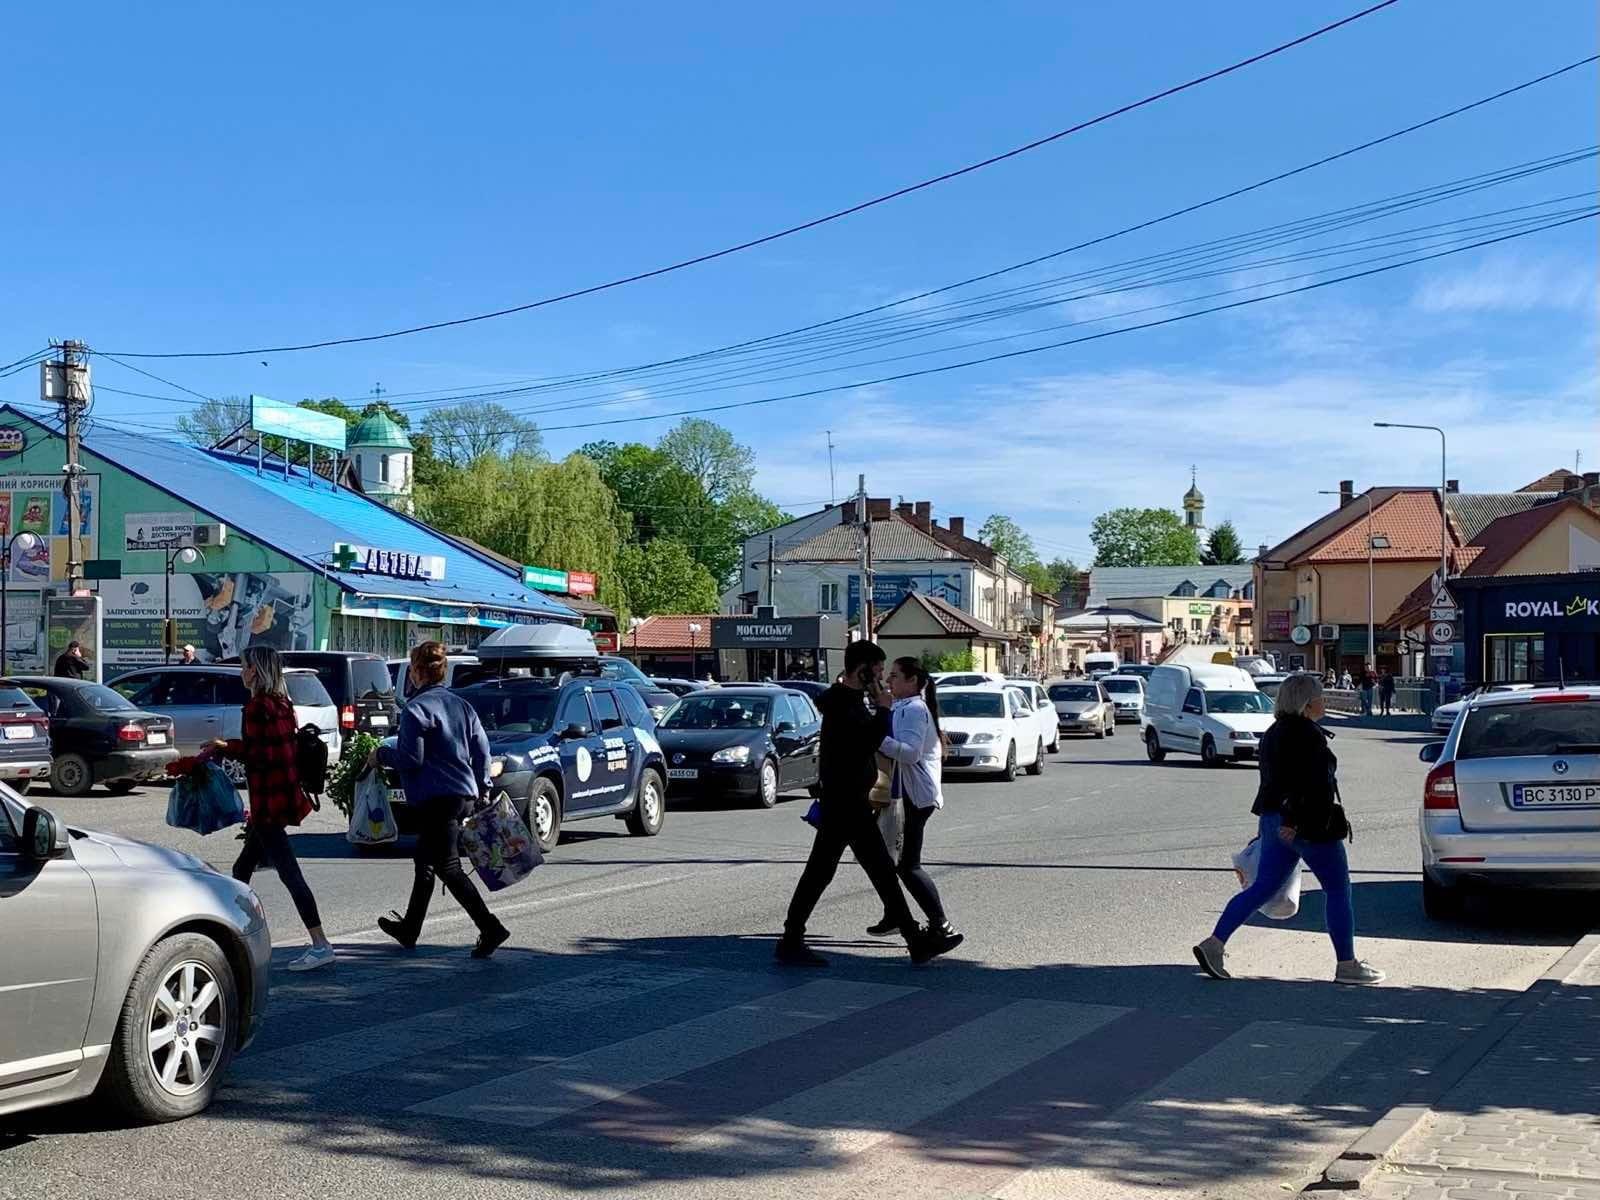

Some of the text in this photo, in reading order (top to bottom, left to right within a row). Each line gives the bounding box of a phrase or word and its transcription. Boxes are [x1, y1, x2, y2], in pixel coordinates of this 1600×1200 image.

[21, 479, 64, 489] КОРИСНИ
[367, 549, 425, 577] АПТЕКА
[1505, 601, 1564, 617] ROYAL
[736, 624, 793, 635] МОСТИСЬКИЙ
[1435, 628, 1450, 637] 40
[1524, 789, 1545, 802] BC
[1549, 788, 1582, 801] 3130
